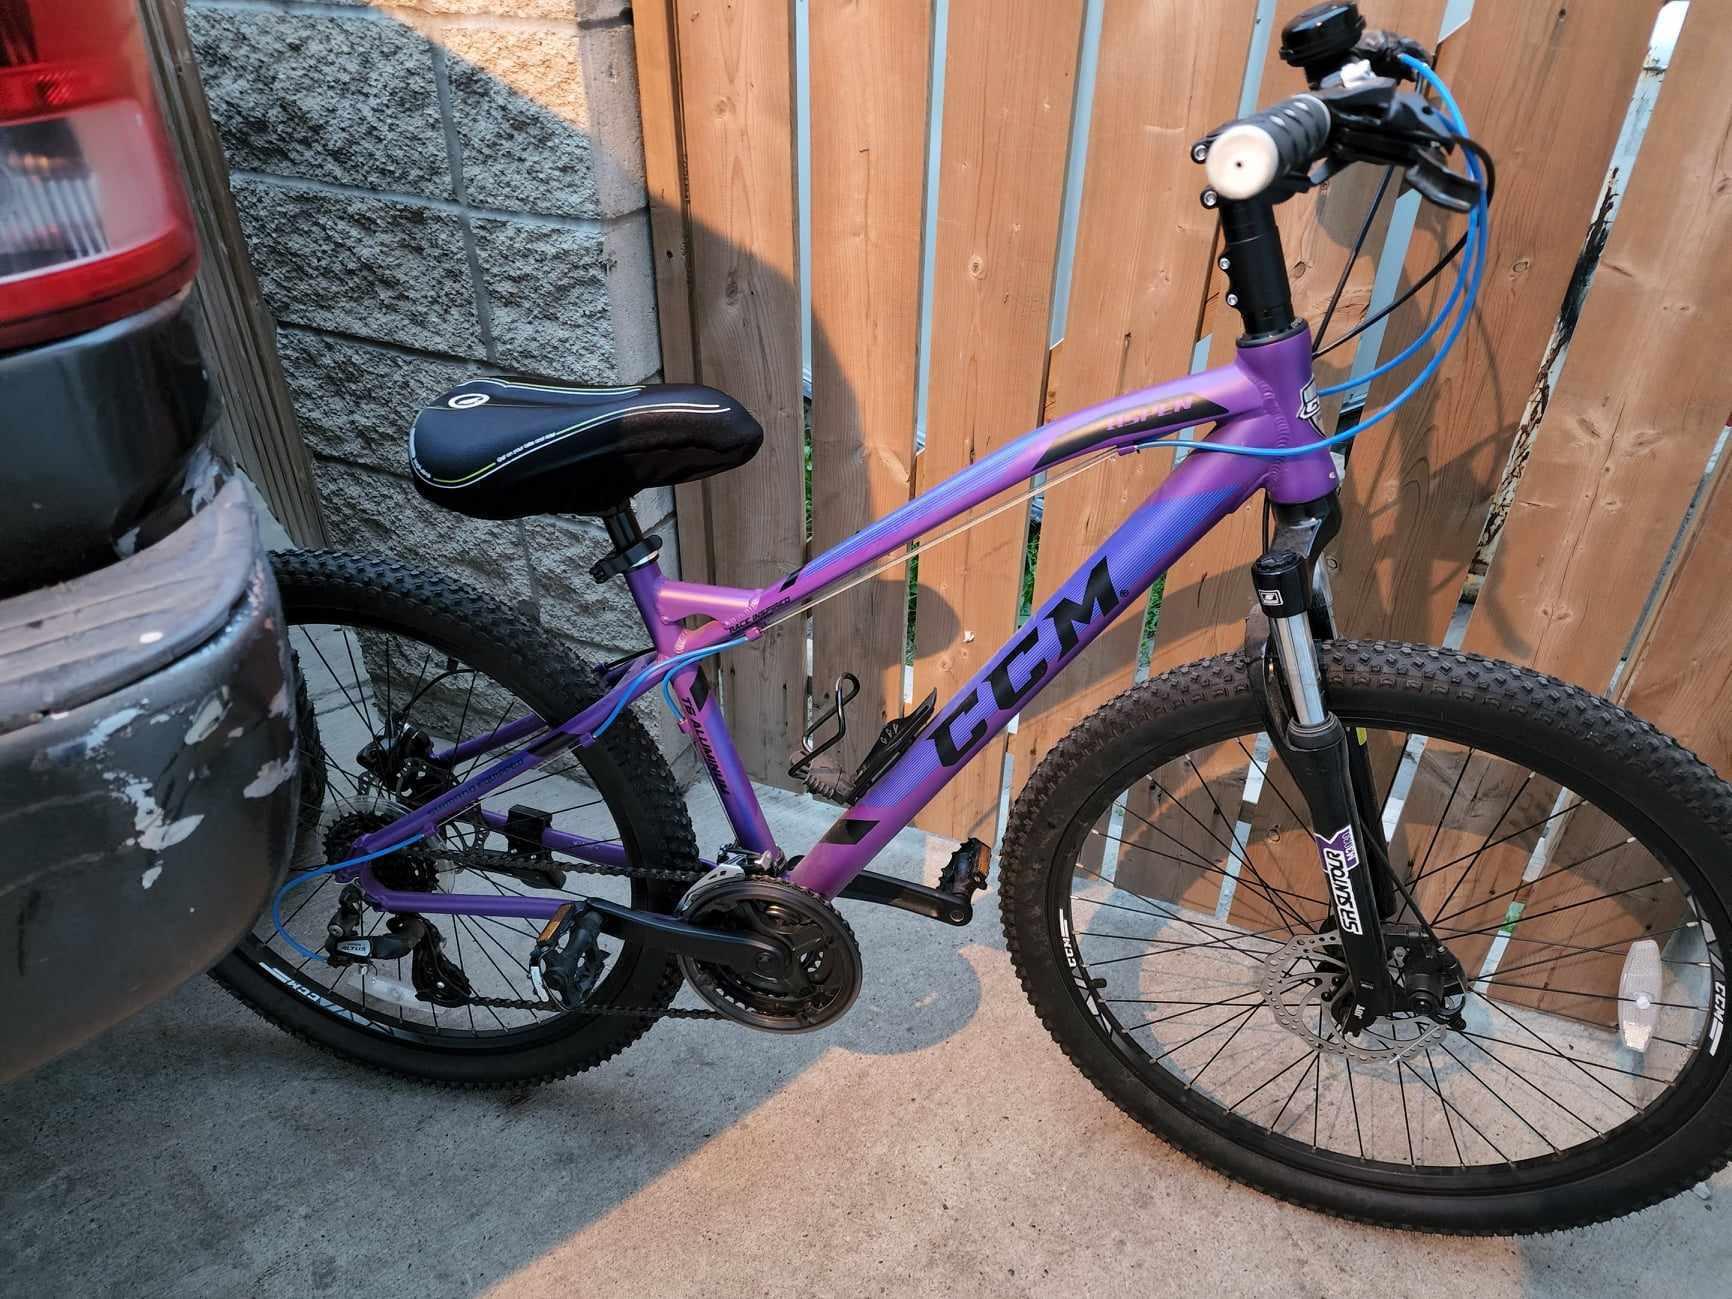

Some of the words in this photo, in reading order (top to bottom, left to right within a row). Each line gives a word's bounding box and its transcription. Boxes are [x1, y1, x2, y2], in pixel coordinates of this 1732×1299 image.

[926, 555, 1120, 768] CCM
[1326, 850, 1353, 907] SUNTOUR
[1062, 937, 1077, 968] CCM
[288, 981, 320, 1002] CCM
[1712, 981, 1727, 1021] CCM
